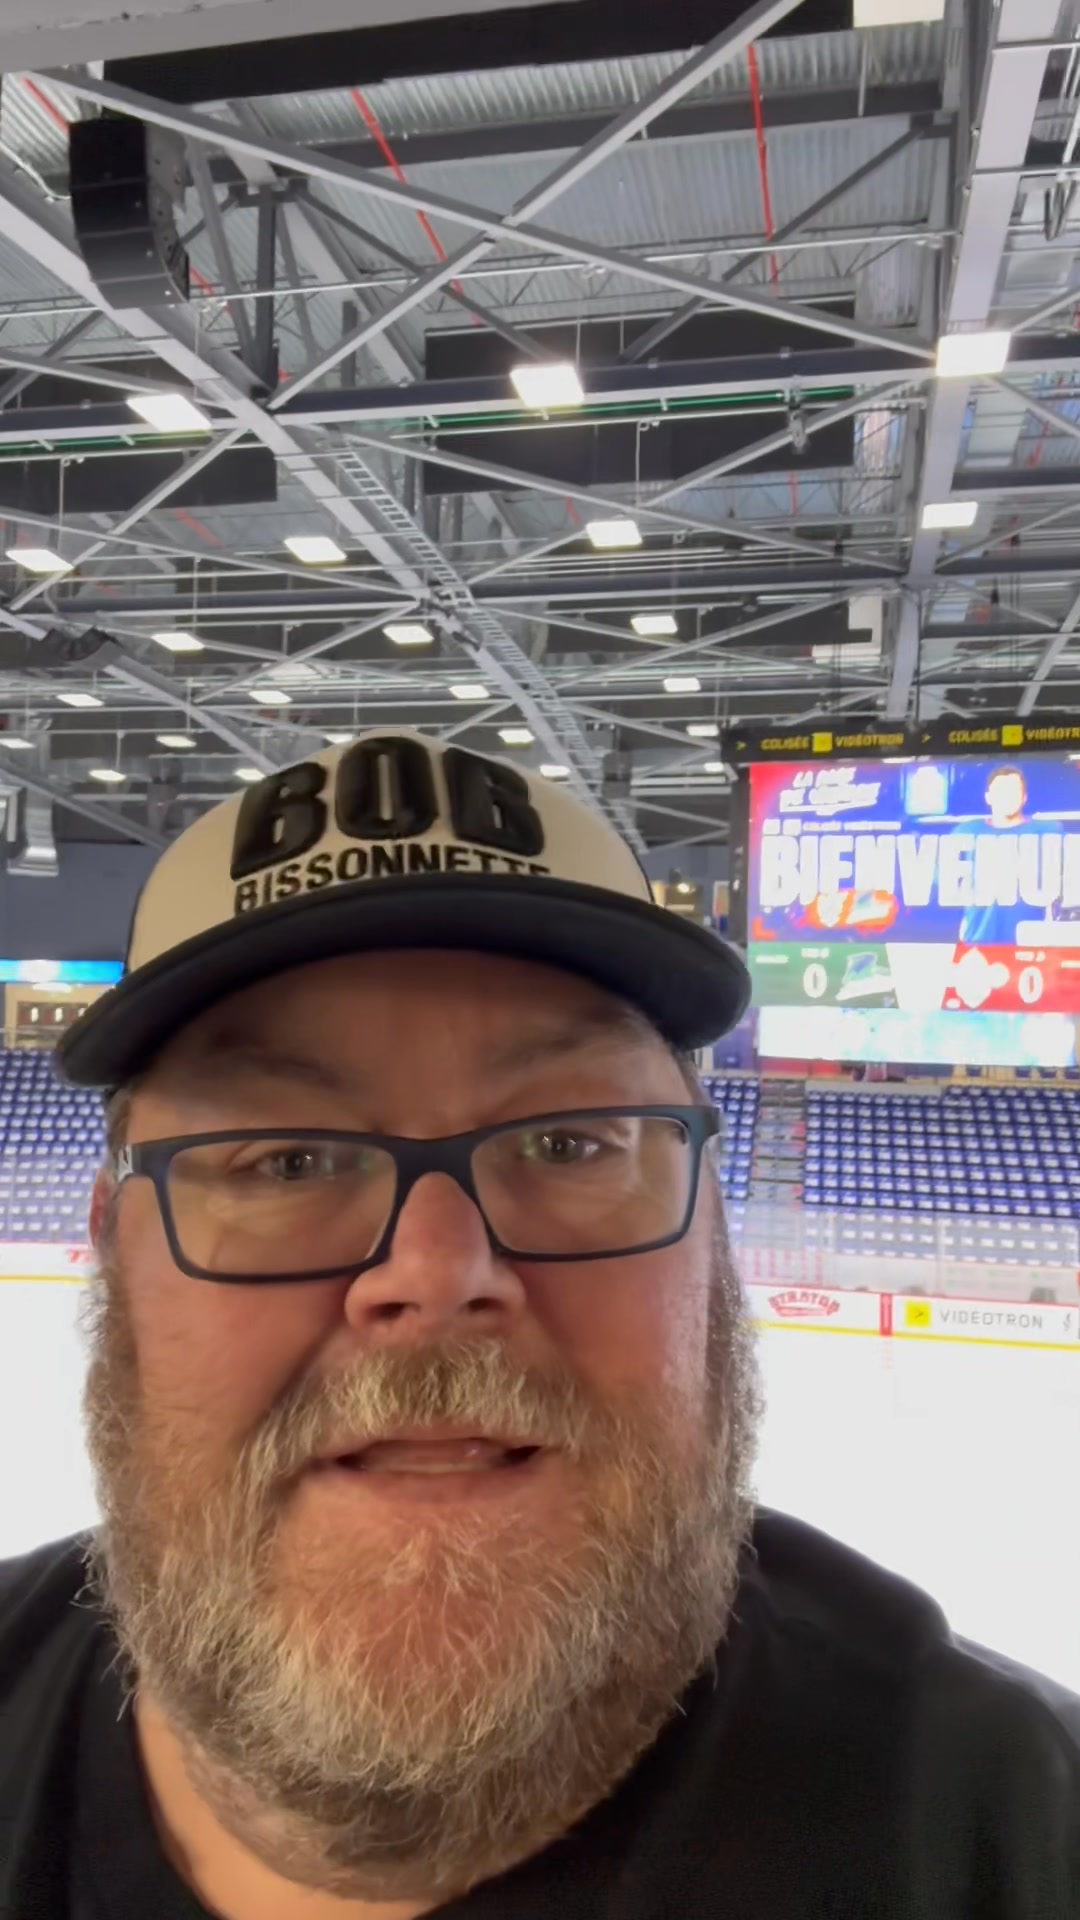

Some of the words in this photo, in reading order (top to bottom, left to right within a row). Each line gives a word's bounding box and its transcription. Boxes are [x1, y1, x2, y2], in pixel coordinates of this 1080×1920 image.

[230, 736, 545, 881] BOB
[803, 963, 827, 998] 0
[1018, 966, 1043, 1004] 0
